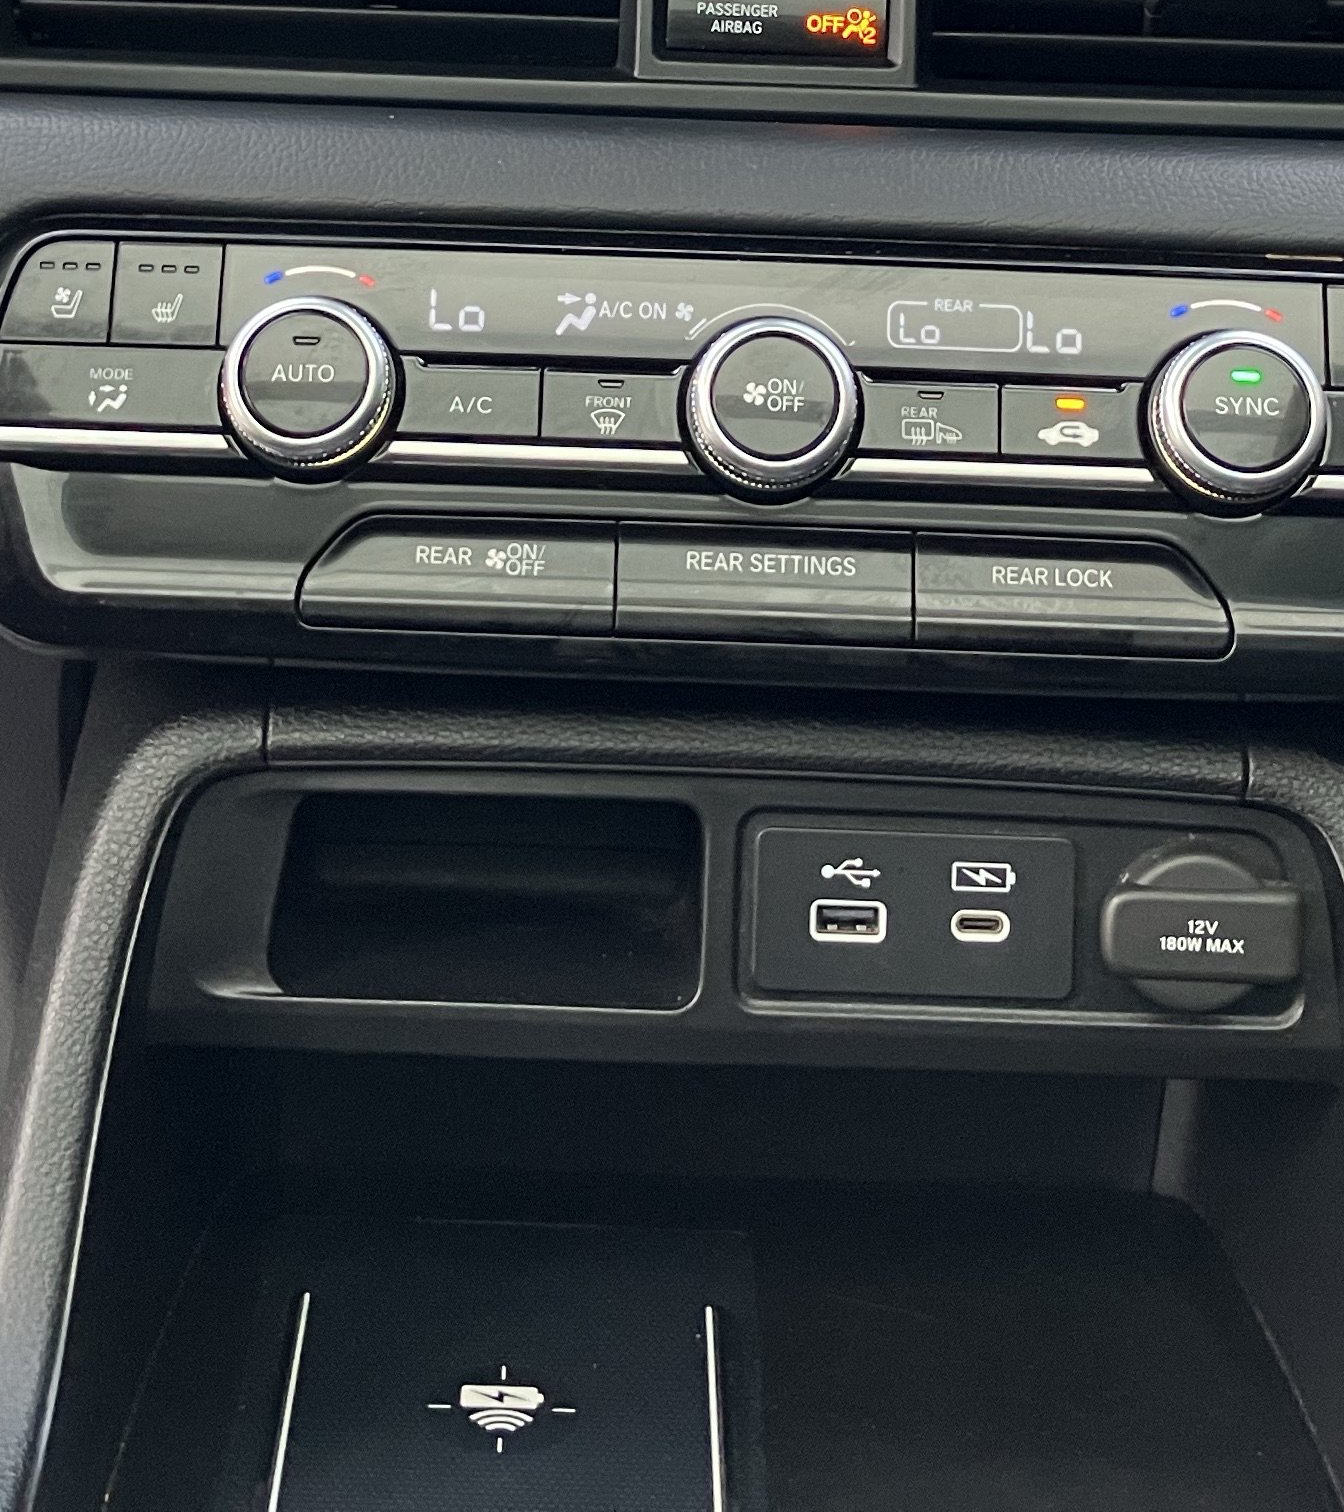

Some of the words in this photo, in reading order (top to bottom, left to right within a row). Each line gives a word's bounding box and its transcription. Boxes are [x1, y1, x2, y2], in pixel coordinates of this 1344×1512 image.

[696, 2, 778, 18] PASSENGER
[711, 20, 763, 35] AIRBAG
[806, 15, 845, 33] OFF
[428, 288, 486, 333] Lo
[598, 301, 633, 320] A/C
[639, 301, 666, 320] ON
[934, 298, 973, 313] REAR
[898, 312, 940, 345] Lo
[1026, 311, 1082, 354] Lo
[89, 367, 134, 381] MODE
[271, 363, 335, 384] AUTO
[768, 378, 804, 395] ON/
[449, 395, 493, 415] A/C
[585, 396, 632, 408] FRONT
[767, 395, 805, 412] OFF
[1214, 396, 1280, 417] SYNC
[902, 406, 938, 418] REAR
[415, 545, 473, 566] REAR
[507, 543, 546, 561] ON/
[506, 559, 545, 576] OFF
[686, 551, 743, 572] REAR
[750, 554, 856, 577] SETTINGS
[992, 566, 1050, 586] REAR
[1055, 568, 1113, 588] LOCK
[1186, 919, 1218, 935] 12V
[1159, 935, 1202, 953] 180W
[1206, 938, 1244, 955] MAX
